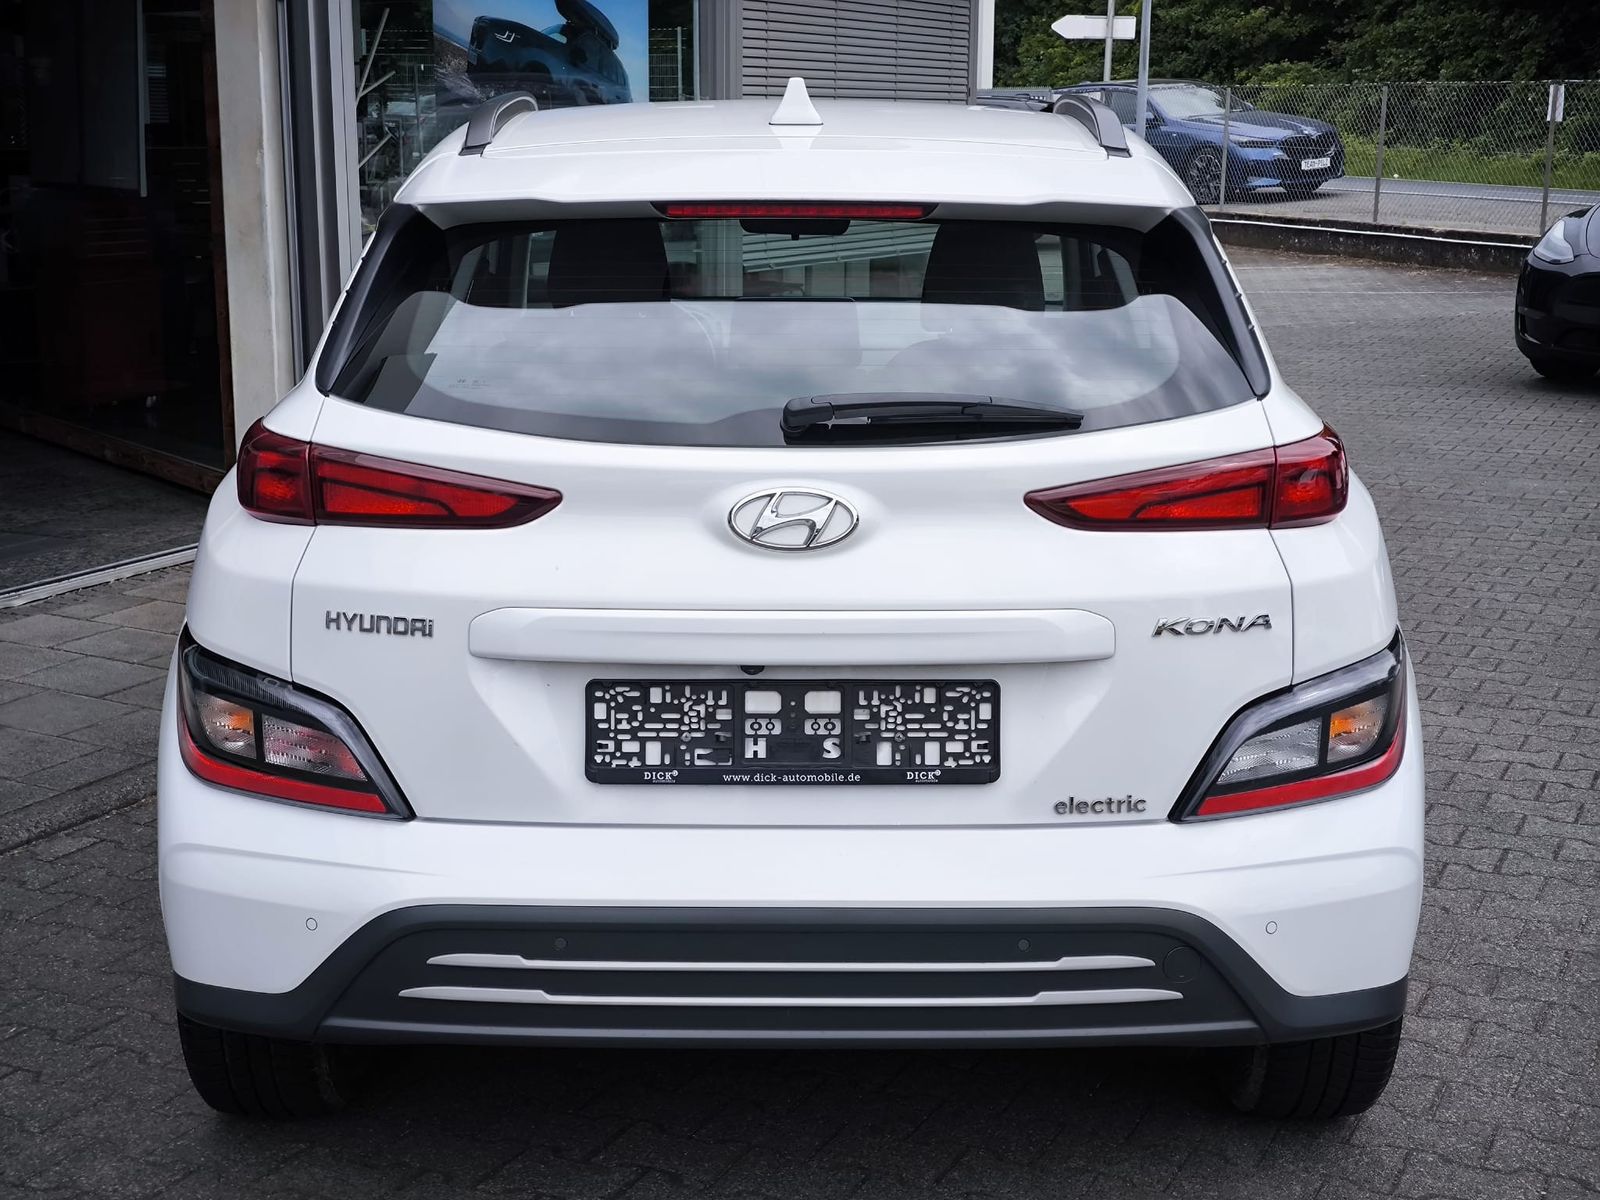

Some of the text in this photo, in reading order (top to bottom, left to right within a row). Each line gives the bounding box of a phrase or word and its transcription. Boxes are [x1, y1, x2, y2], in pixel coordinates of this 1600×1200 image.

[1151, 613, 1272, 638] KONA
[643, 771, 672, 780] DICK
[722, 772, 861, 782] www.dick-automobile.de
[906, 771, 935, 780] DICK
[1053, 794, 1147, 815] electric
